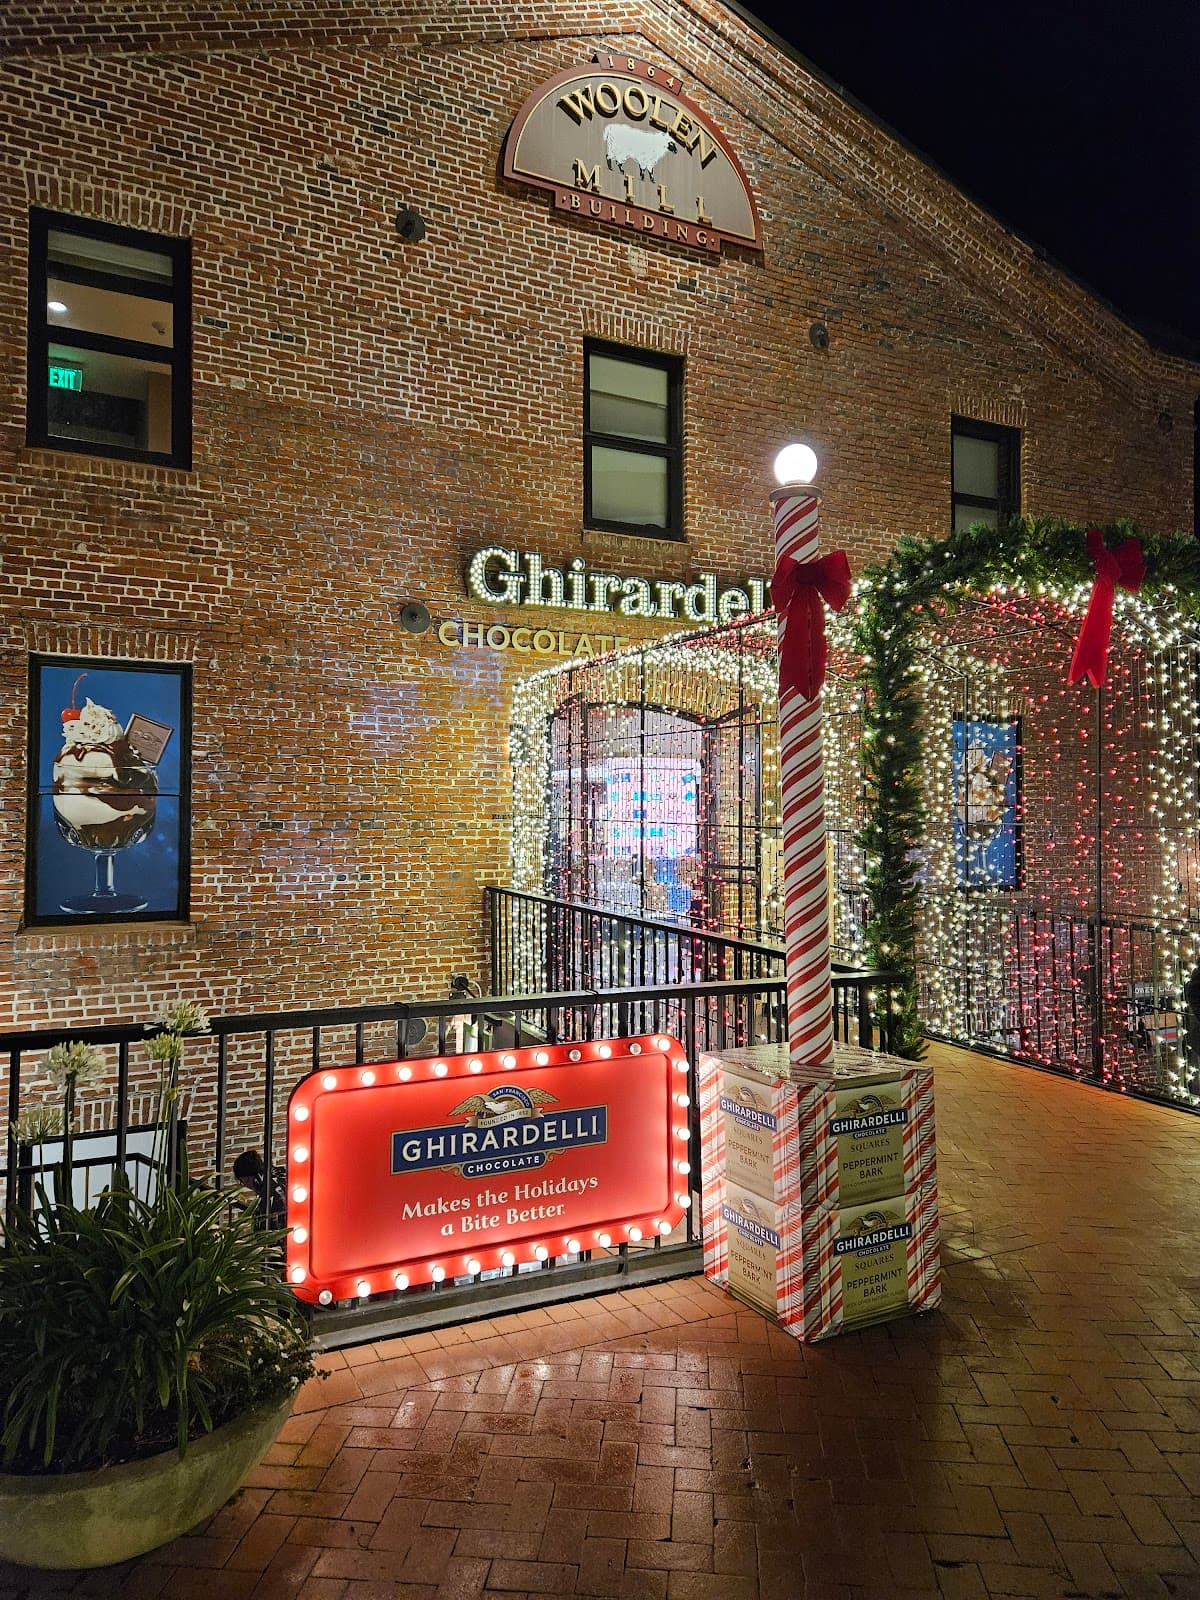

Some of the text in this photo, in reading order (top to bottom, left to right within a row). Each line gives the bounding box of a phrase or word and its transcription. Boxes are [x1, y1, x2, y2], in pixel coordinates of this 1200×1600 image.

[608, 55, 675, 88] 1864
[560, 82, 717, 166] WOOLEN
[575, 158, 713, 223] MILL
[570, 195, 708, 244] BUILDING
[49, 367, 76, 389] EXIT
[470, 544, 772, 622] Ghirardel
[720, 1099, 776, 1129] GHIRARDELLI
[832, 1111, 905, 1132] GHIRARDELLI
[401, 1115, 598, 1162] GHIRARDELLI
[854, 1128, 886, 1139] CHOCOLATE
[850, 1138, 890, 1153] SQUARES
[467, 1155, 540, 1174] CHOCOLATE
[739, 1155, 758, 1170] BARK
[842, 1152, 899, 1171] PEPPERMINT
[859, 1166, 883, 1179] BARK
[401, 1176, 599, 1221] Makes the Holidays
[441, 1223, 454, 1237] a
[461, 1215, 500, 1234] Bite
[723, 1208, 778, 1246] GHIRARDELLI
[836, 1226, 909, 1252] GHIRARDELLI
[858, 1245, 890, 1257] CHOCOLATE
[855, 1253, 895, 1272] SQUARES
[742, 1267, 761, 1285] BARK
[846, 1268, 903, 1291] PEPPERMINT
[863, 1284, 887, 1298] BARK
